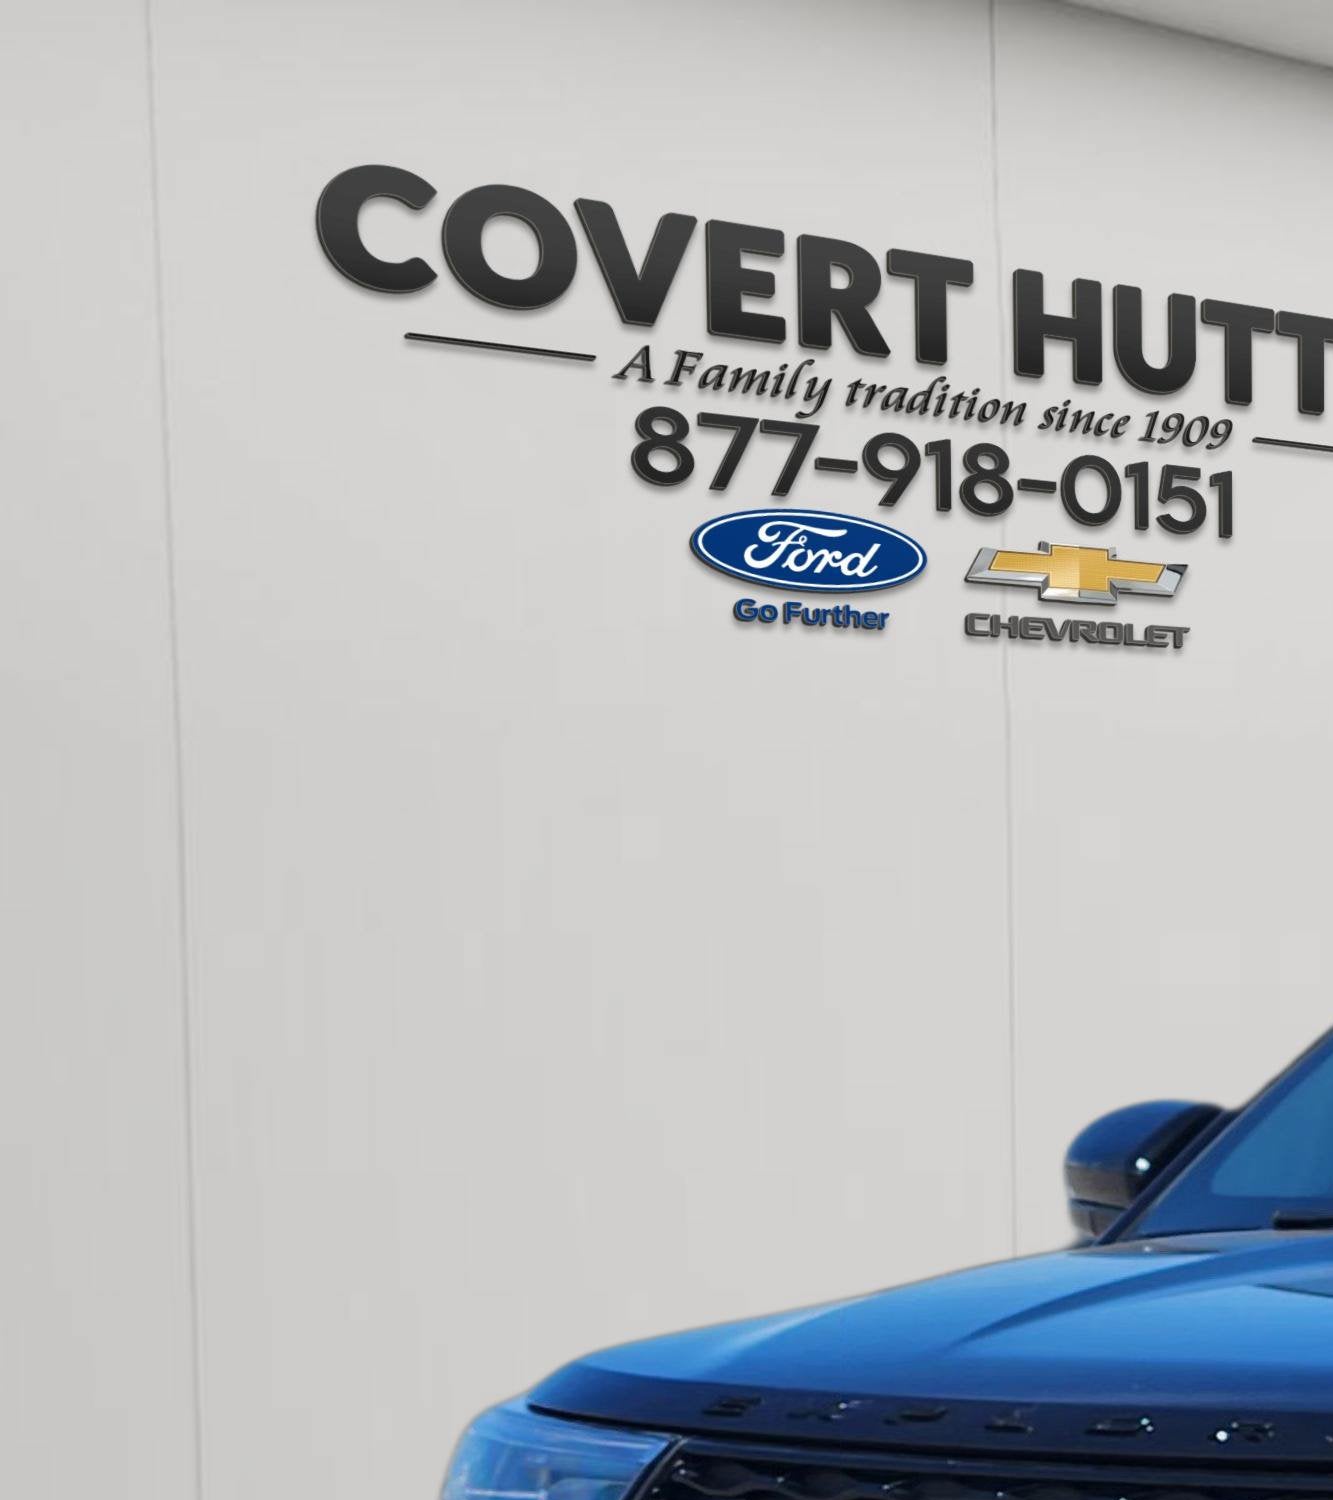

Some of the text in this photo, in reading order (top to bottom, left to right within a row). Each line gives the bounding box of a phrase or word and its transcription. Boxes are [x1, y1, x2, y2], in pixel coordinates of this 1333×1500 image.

[316, 163, 974, 364] COVERT
[613, 344, 1234, 450] A Family tradition since 1909
[631, 406, 1233, 539] 877-918-0151
[744, 520, 881, 578] Ford
[733, 598, 890, 630] Go Further
[964, 612, 1190, 649] CHEVROLET
